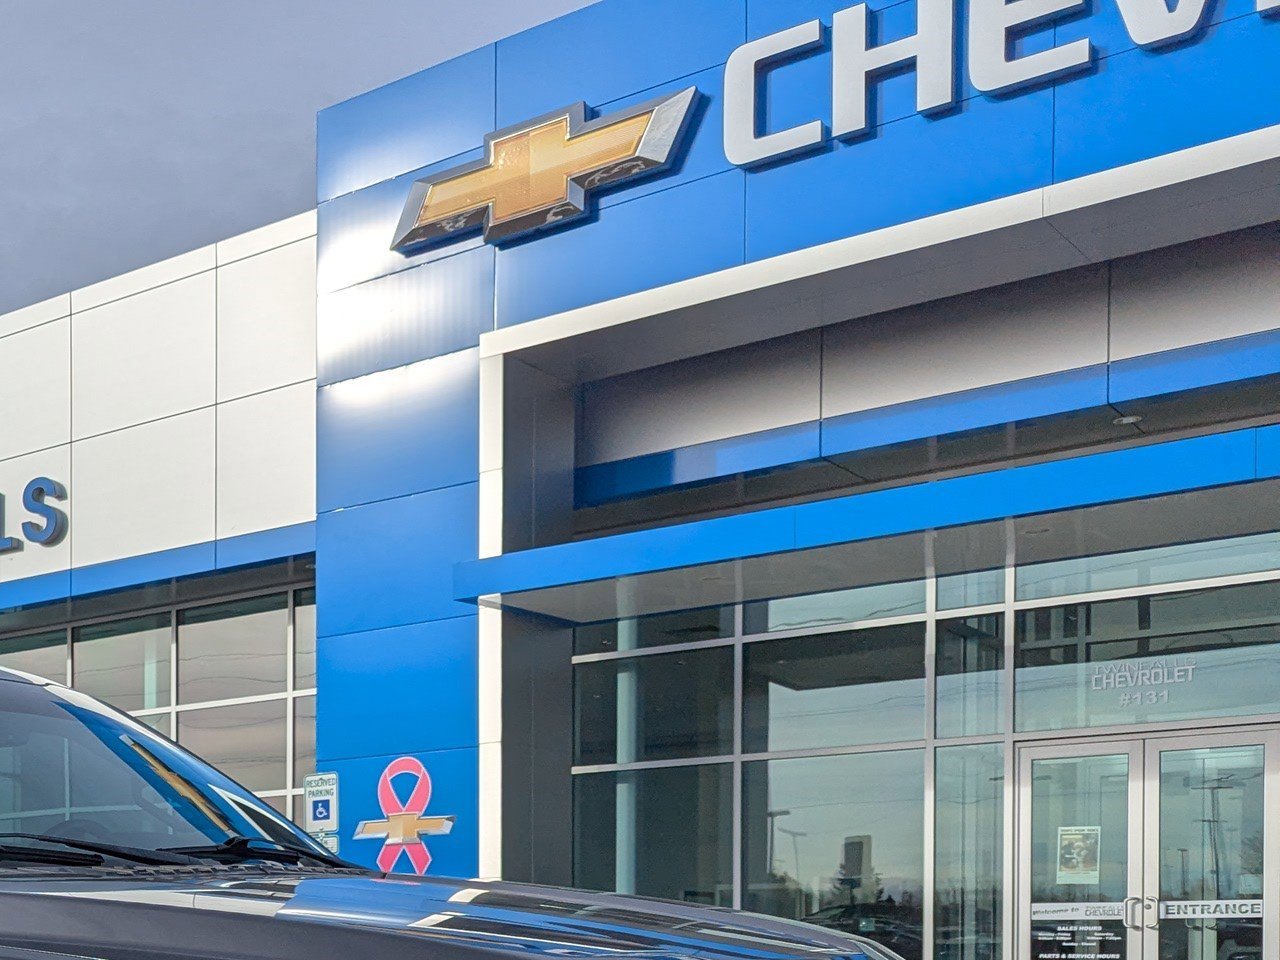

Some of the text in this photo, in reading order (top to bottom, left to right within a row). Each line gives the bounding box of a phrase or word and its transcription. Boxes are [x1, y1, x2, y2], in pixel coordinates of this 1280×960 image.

[1091, 665, 1197, 690] CHEVROLET
[1119, 688, 1170, 707] #131
[306, 777, 337, 788] RESERVED
[307, 788, 335, 799] PARKING
[1165, 903, 1262, 915] ENTRANCE
